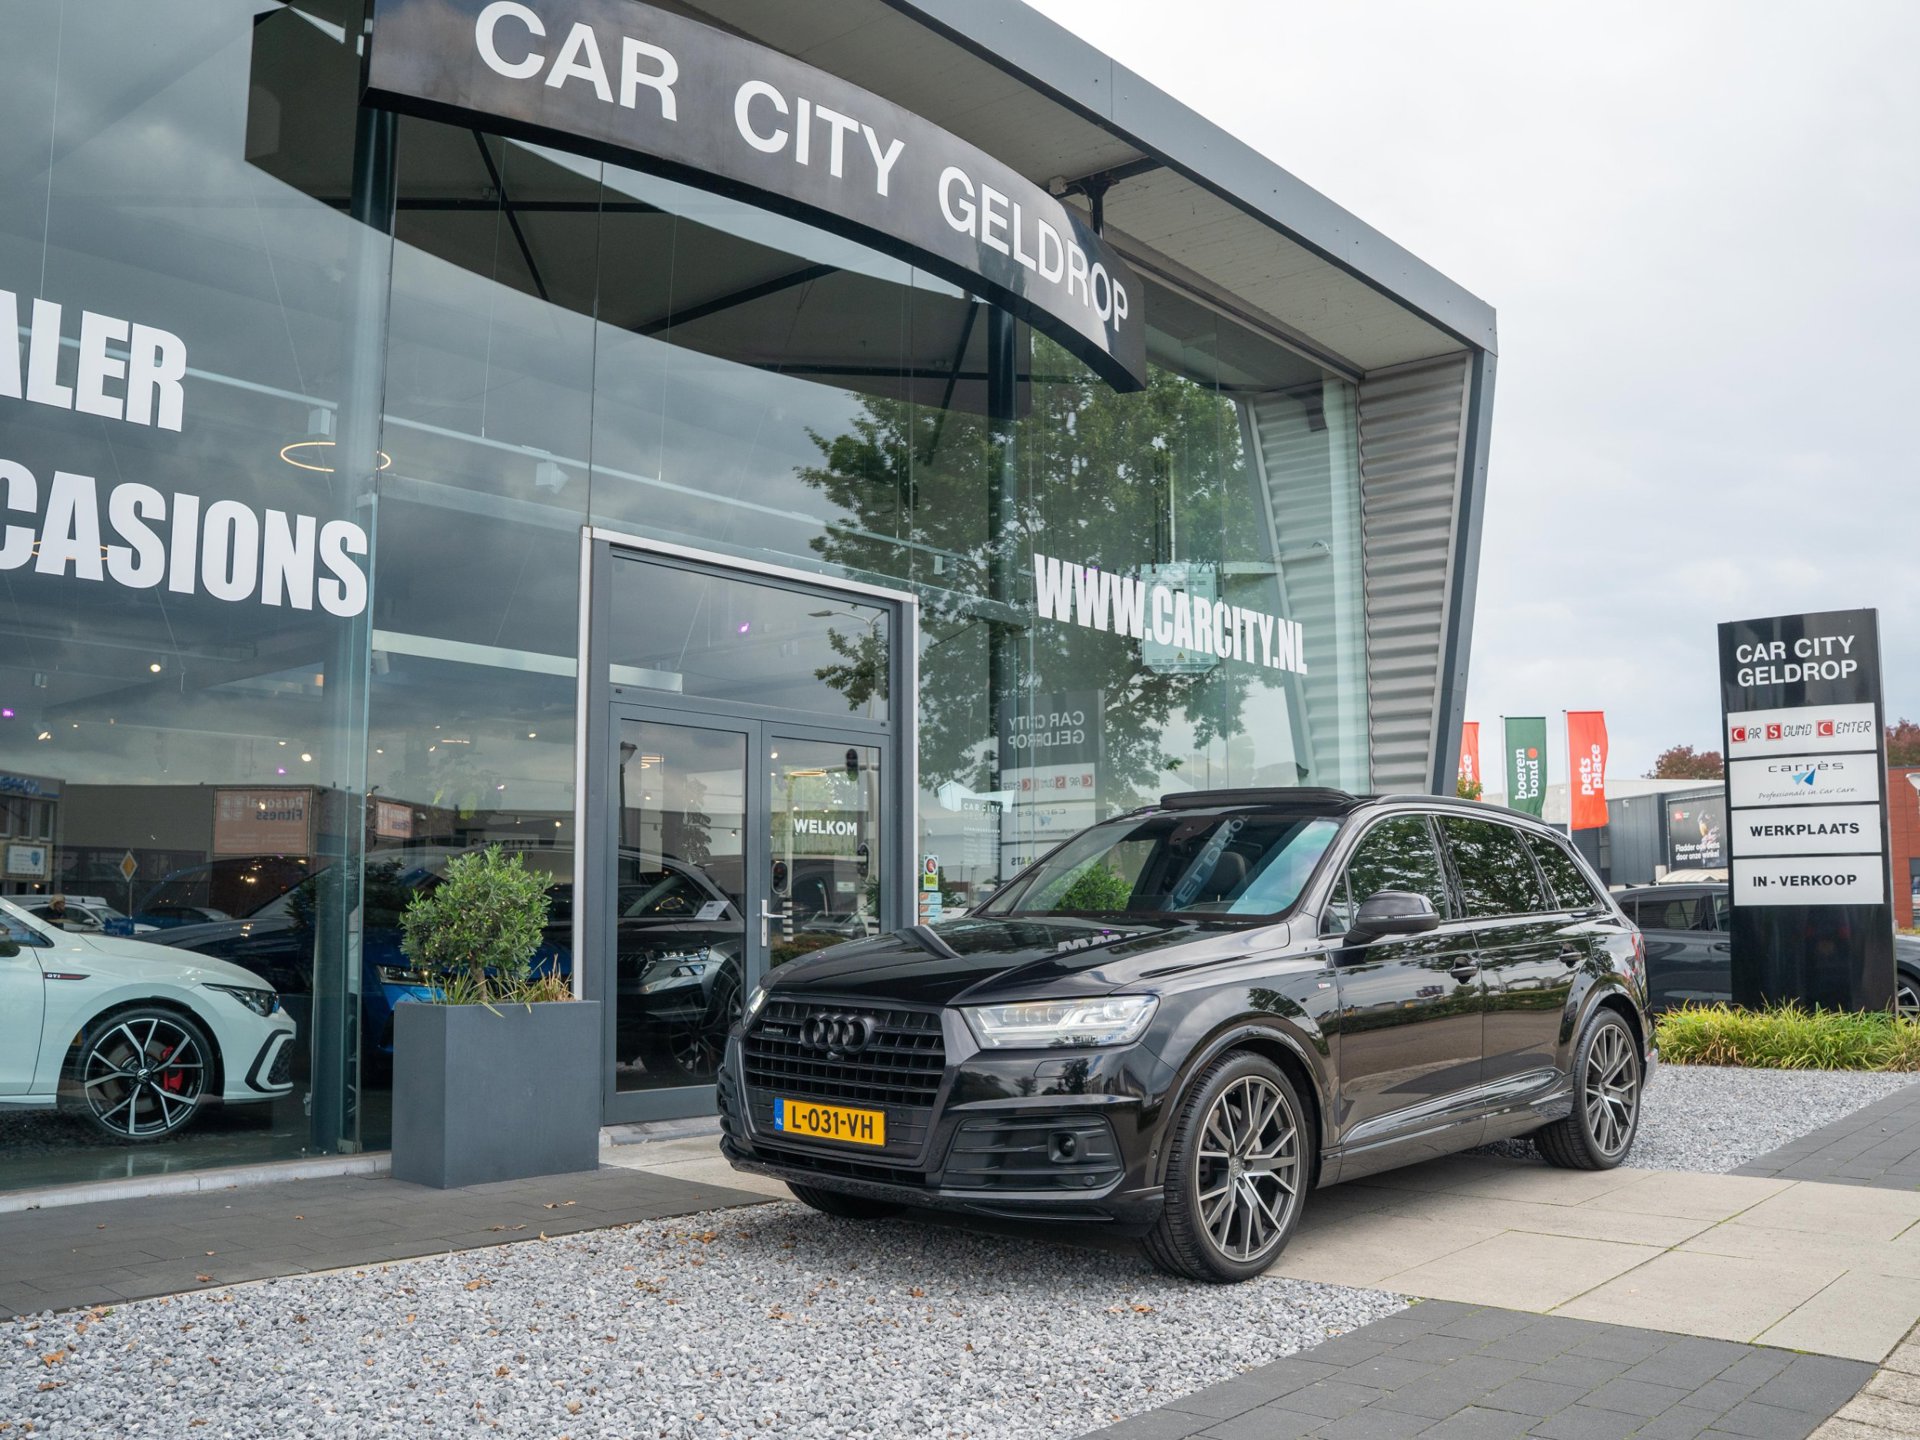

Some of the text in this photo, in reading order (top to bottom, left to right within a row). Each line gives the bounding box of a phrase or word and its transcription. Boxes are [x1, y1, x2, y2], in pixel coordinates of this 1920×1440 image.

[474, 1, 1129, 332] CAR CITY GELDROP
[1034, 553, 1308, 675] WWW.CARCITY.NL
[1736, 635, 1855, 663] CAR CITY
[1737, 660, 1858, 687] GELDROP
[1732, 720, 1872, 742] CAR SOUND CENTER
[1515, 748, 1527, 800] boeren
[1526, 759, 1539, 798] bond
[1579, 757, 1594, 796] pets
[1591, 744, 1604, 789] place
[1768, 761, 1844, 773] carrès
[1758, 789, 1805, 801] Professionals
[794, 818, 858, 836] WELKOM
[1750, 823, 1860, 837] WERKPLAATS
[1753, 876, 1767, 887] IN
[1779, 875, 1857, 887] VERKOOP
[792, 1105, 873, 1139] L-031-VH
